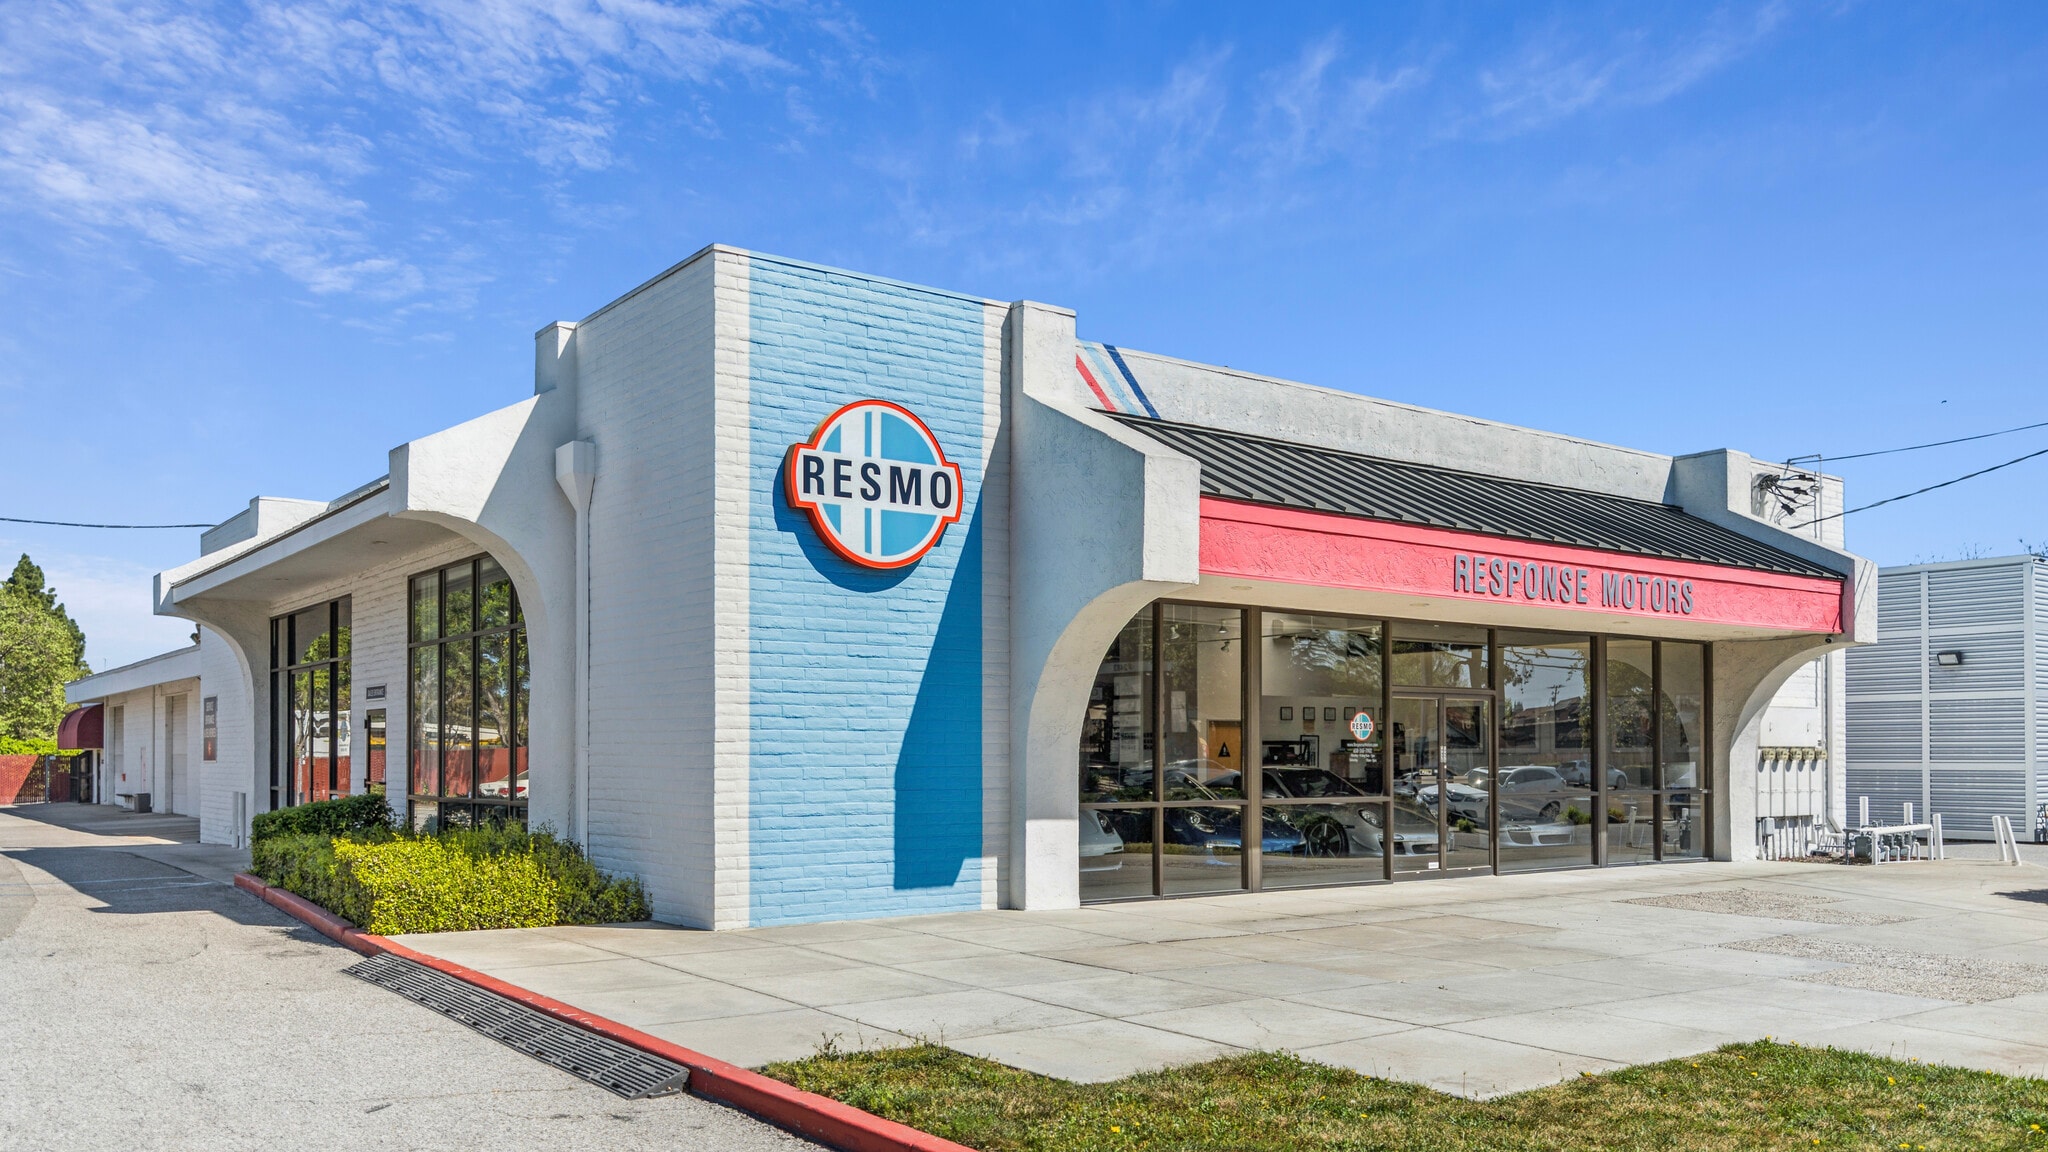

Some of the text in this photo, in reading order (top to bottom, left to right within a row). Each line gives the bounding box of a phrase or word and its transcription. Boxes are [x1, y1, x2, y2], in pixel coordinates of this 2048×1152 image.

[803, 454, 951, 509] RESMO
[1454, 554, 1693, 614] RESPONSE MOTORS
[1352, 722, 1372, 730] RESMO
